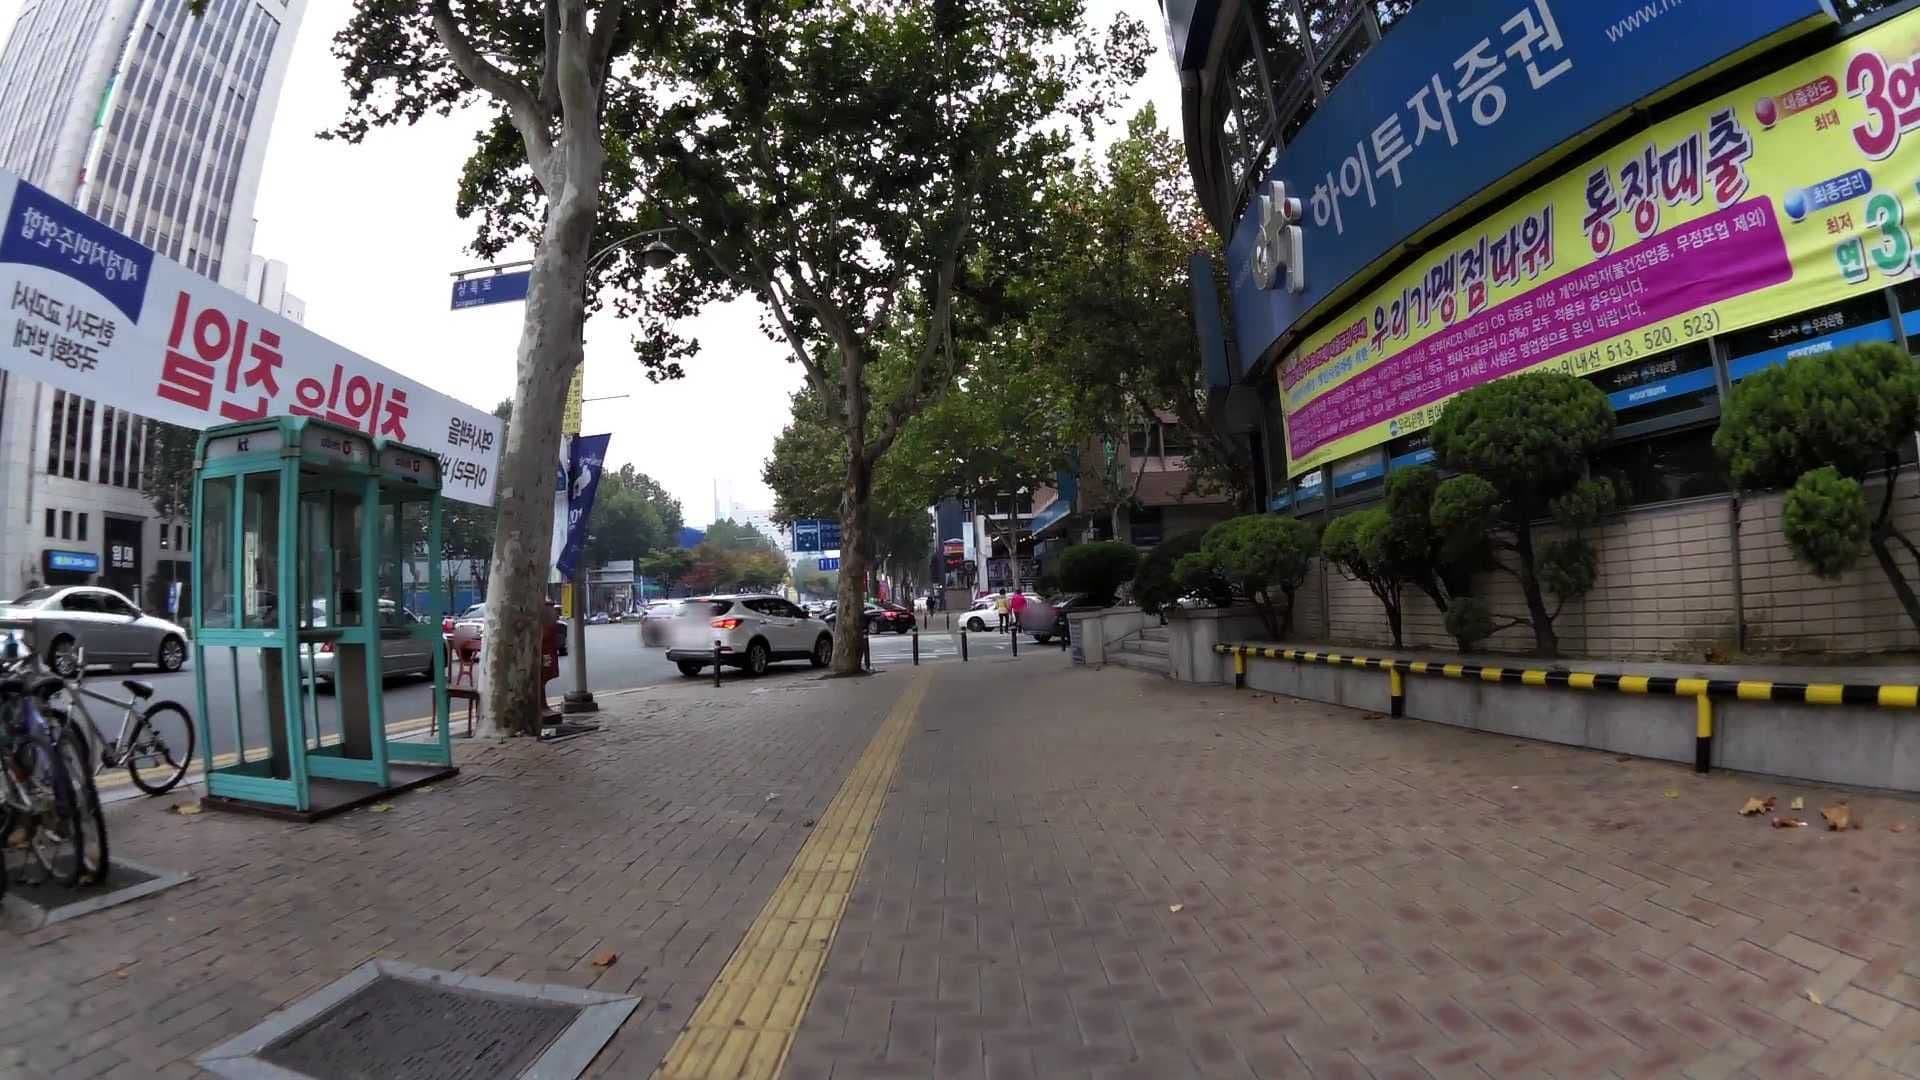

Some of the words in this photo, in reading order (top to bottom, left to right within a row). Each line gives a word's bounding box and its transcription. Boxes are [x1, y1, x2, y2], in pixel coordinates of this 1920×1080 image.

[1782, 81, 1833, 111] 대출한도
[1310, 0, 1573, 235] 하이투자증권
[1814, 109, 1841, 131] 최대
[1813, 171, 1864, 203] 최종금리
[1370, 204, 1555, 354] 우리가맹점파워
[1583, 107, 1752, 258] 통장대출
[1826, 212, 1853, 235] 최저
[1507, 301, 1533, 322] 6등급
[1536, 290, 1556, 309] 이상
[1734, 207, 1766, 233] 제외)
[1835, 235, 1868, 283] 연
[1532, 314, 1552, 332] 모두
[1554, 301, 1586, 323] 적용된
[1589, 278, 1649, 313] 경우입니다.
[1683, 308, 1720, 337] 523)
[1520, 328, 1569, 358] 영업점으로
[1571, 319, 1595, 339] 문의
[1597, 299, 1647, 327] 바랍니다.
[237, 438, 249, 452] kt
